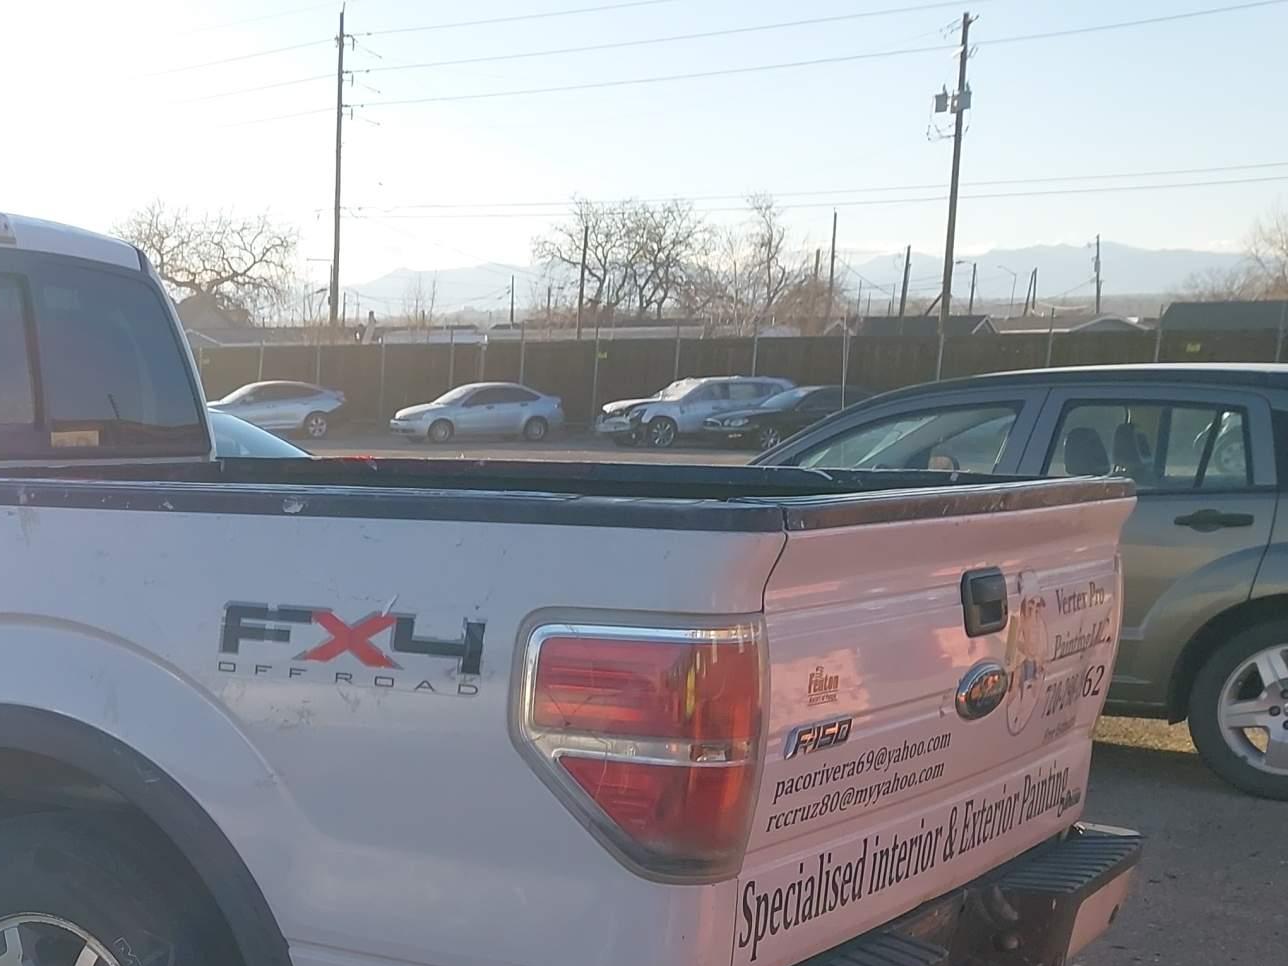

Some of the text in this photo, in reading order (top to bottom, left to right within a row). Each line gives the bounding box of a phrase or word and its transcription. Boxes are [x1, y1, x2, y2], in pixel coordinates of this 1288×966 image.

[1055, 581, 1105, 616] Vertex Pro
[219, 600, 487, 676] FX4
[765, 762, 945, 833] rccruz80@myyahoo.com
[772, 732, 952, 806] pacorivera69@yahoo.com
[738, 759, 1070, 962] Specialised interior & Exterior Painting
